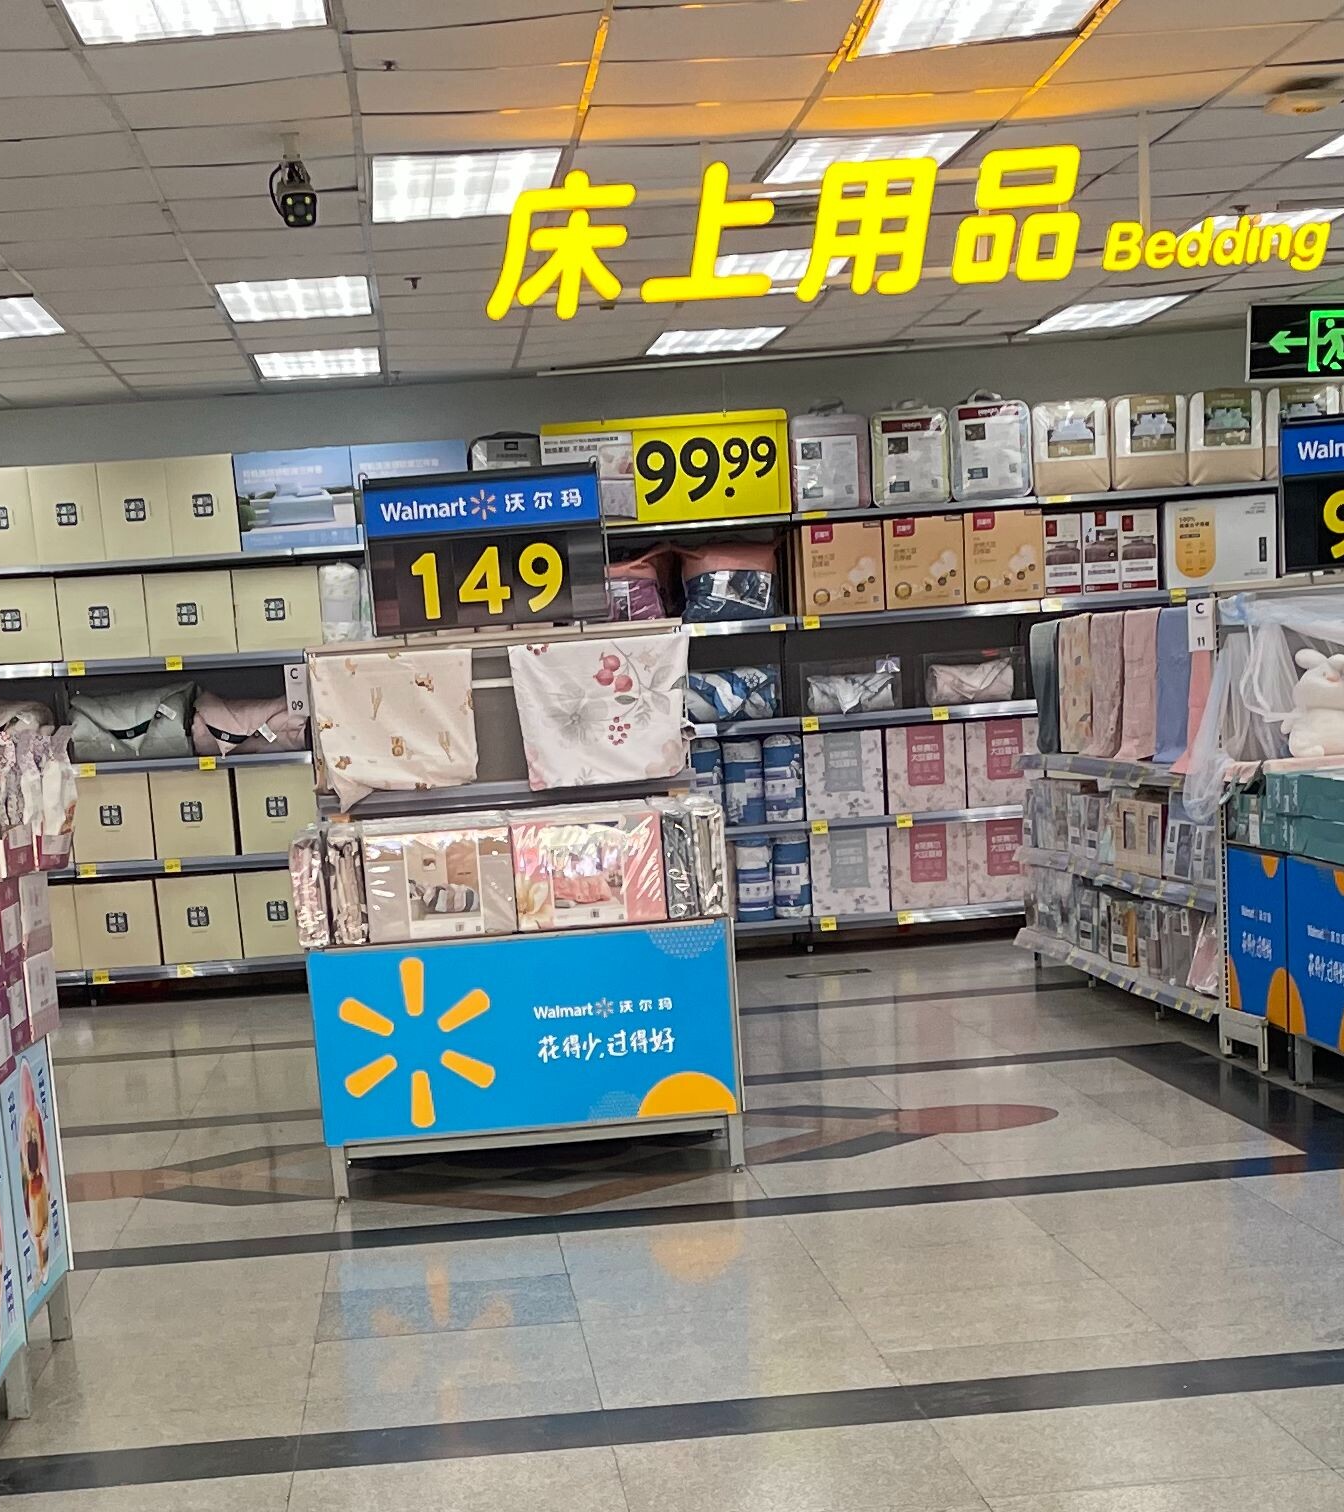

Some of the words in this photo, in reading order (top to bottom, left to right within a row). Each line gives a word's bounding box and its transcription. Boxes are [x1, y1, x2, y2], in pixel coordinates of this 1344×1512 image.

[485, 143, 1083, 321] 床上用品
[1102, 217, 1332, 272] Bedding
[635, 434, 777, 506] 99.99
[380, 496, 468, 522] Walmart
[504, 488, 583, 512] 沃尔玛
[410, 541, 564, 621] 149
[1194, 602, 1205, 615] C
[289, 667, 299, 680] C
[291, 700, 304, 711] 09
[533, 1003, 594, 1020] Walmart
[618, 997, 673, 1014] 沃尔玛
